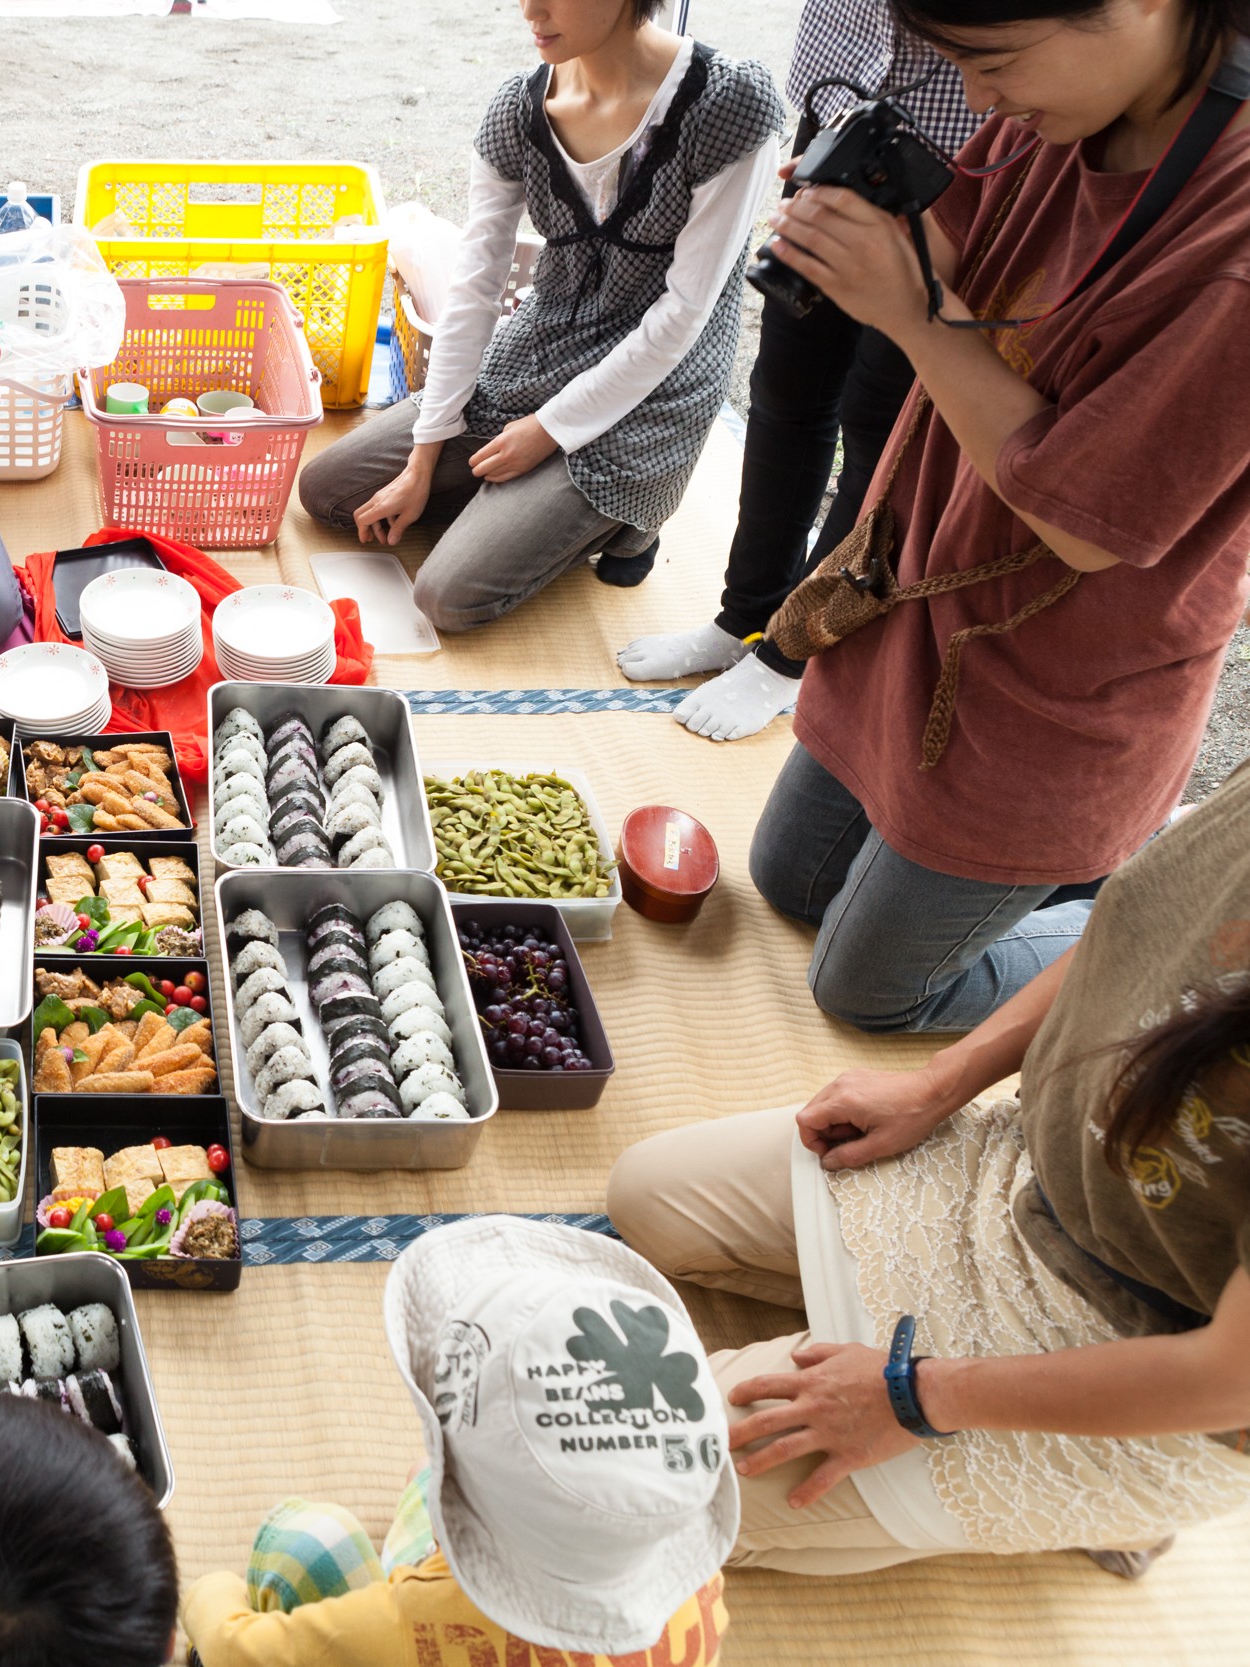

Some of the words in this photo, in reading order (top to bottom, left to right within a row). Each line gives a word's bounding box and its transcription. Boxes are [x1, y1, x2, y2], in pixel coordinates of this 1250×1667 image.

[527, 1359, 606, 1380] HAPPY
[545, 1383, 625, 1402] BEANS
[536, 1407, 687, 1430] COLLECTION
[560, 1434, 659, 1453] NUMBER
[661, 1433, 723, 1474] 56
